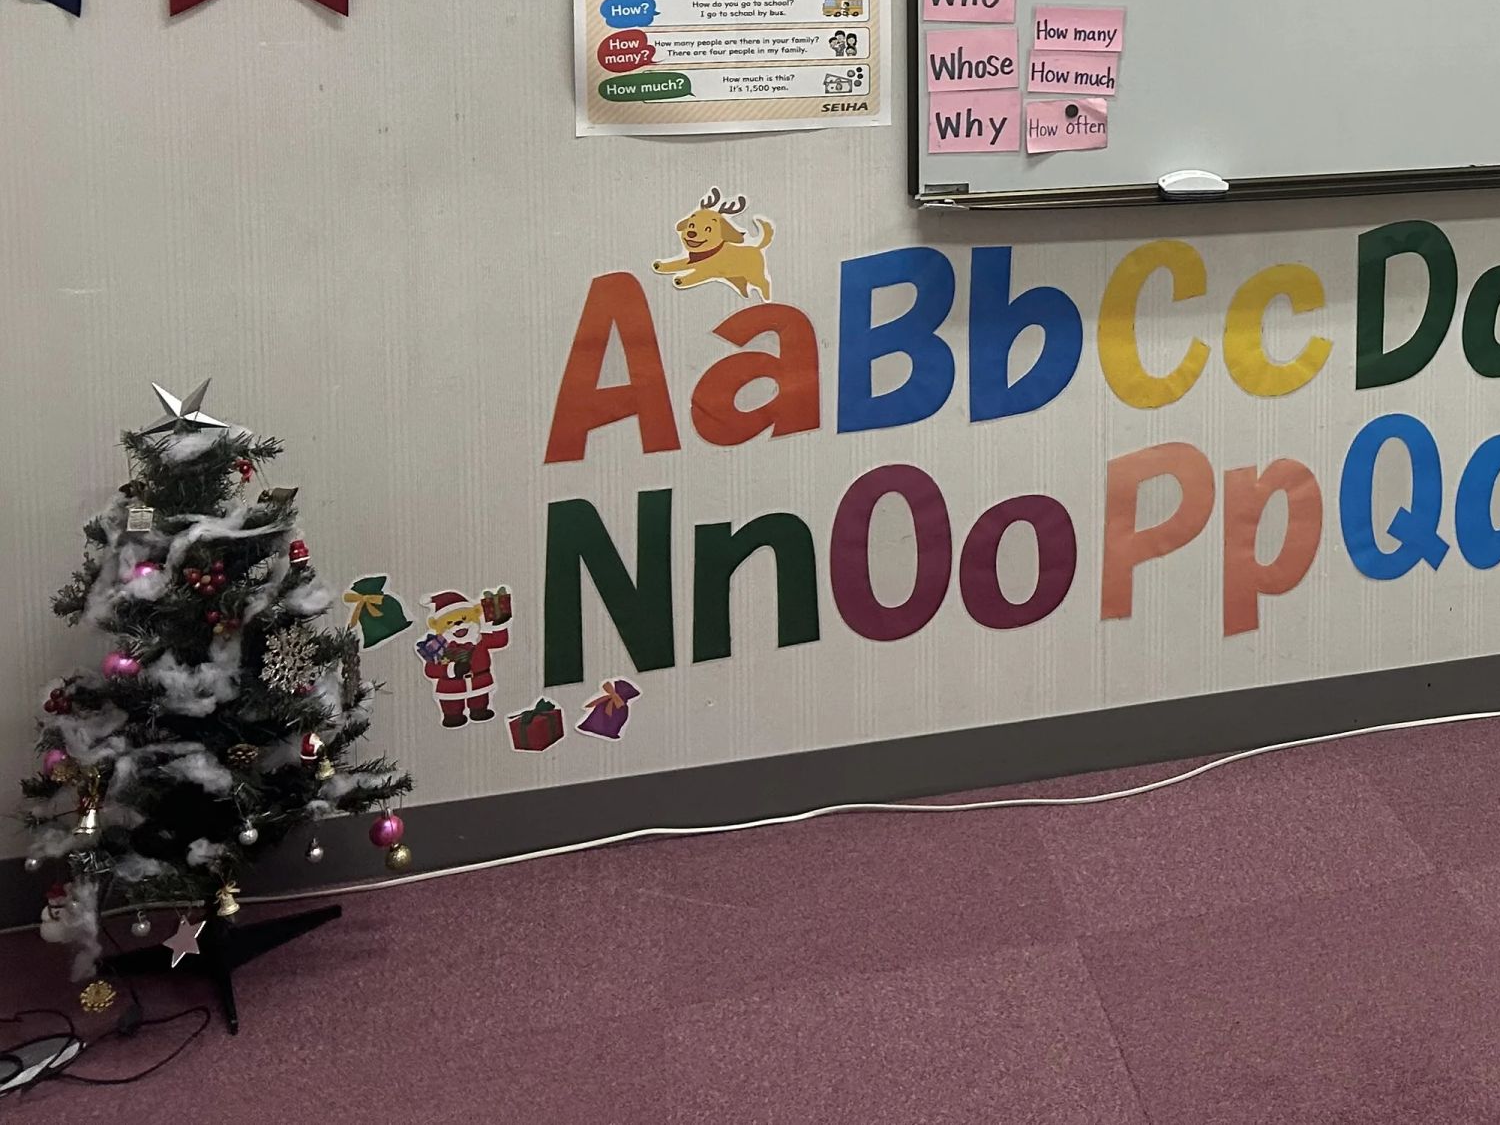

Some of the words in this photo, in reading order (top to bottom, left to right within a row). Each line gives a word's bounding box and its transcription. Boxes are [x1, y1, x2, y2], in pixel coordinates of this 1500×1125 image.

[611, 2, 649, 16] How?
[740, 1, 752, 9] go
[763, 0, 795, 7] school?
[700, 10, 705, 18] I
[706, 12, 717, 20] go
[757, 10, 768, 18] by
[1036, 19, 1068, 41] How
[1073, 27, 1118, 48] many
[609, 38, 639, 50] How
[696, 39, 723, 48] people
[739, 37, 761, 45] there
[771, 38, 790, 46] your
[791, 36, 820, 45] family?
[605, 49, 650, 65] many?
[666, 49, 691, 57] There
[709, 48, 727, 56] four
[728, 47, 755, 56] people
[767, 48, 779, 56] my
[781, 46, 808, 55] family.
[930, 46, 1014, 81] Whose
[774, 74, 796, 82] this?
[1031, 62, 1070, 85] How
[1074, 67, 1115, 90] much
[606, 84, 638, 95] How
[641, 78, 684, 93] much?
[745, 85, 770, 93] 1,500
[771, 85, 789, 93] yen.
[820, 102, 869, 113] SEIHA
[935, 108, 1008, 145] Why
[1029, 116, 1058, 138] How
[1065, 114, 1107, 136] often
